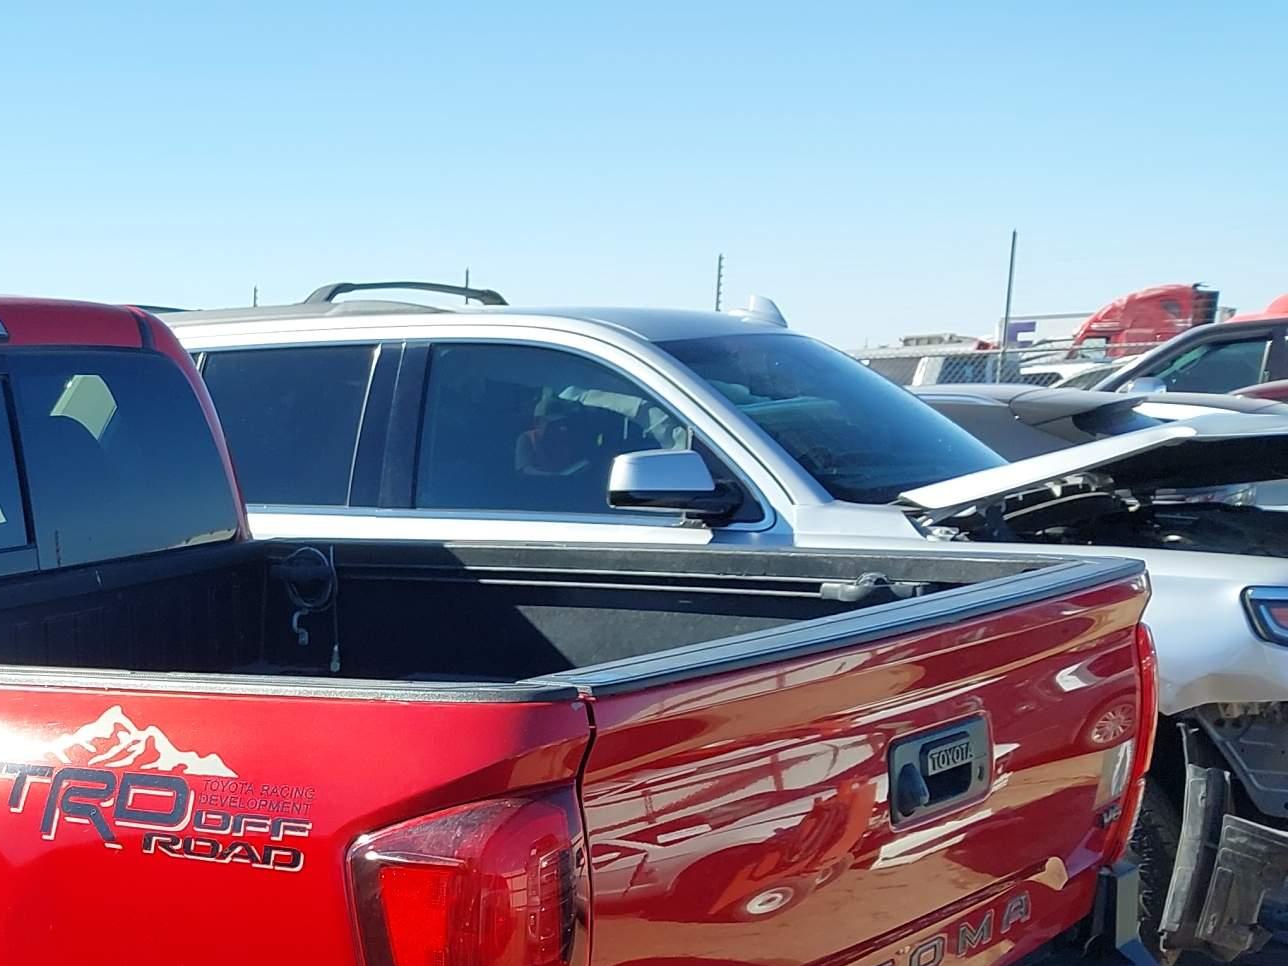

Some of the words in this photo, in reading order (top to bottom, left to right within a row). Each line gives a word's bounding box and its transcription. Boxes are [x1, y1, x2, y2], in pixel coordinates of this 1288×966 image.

[202, 778, 256, 797] TOYOTA
[259, 783, 316, 800] RACING
[198, 793, 313, 815] DEVELOPMENT
[193, 809, 313, 841] OFF
[141, 832, 305, 873] ROAD
